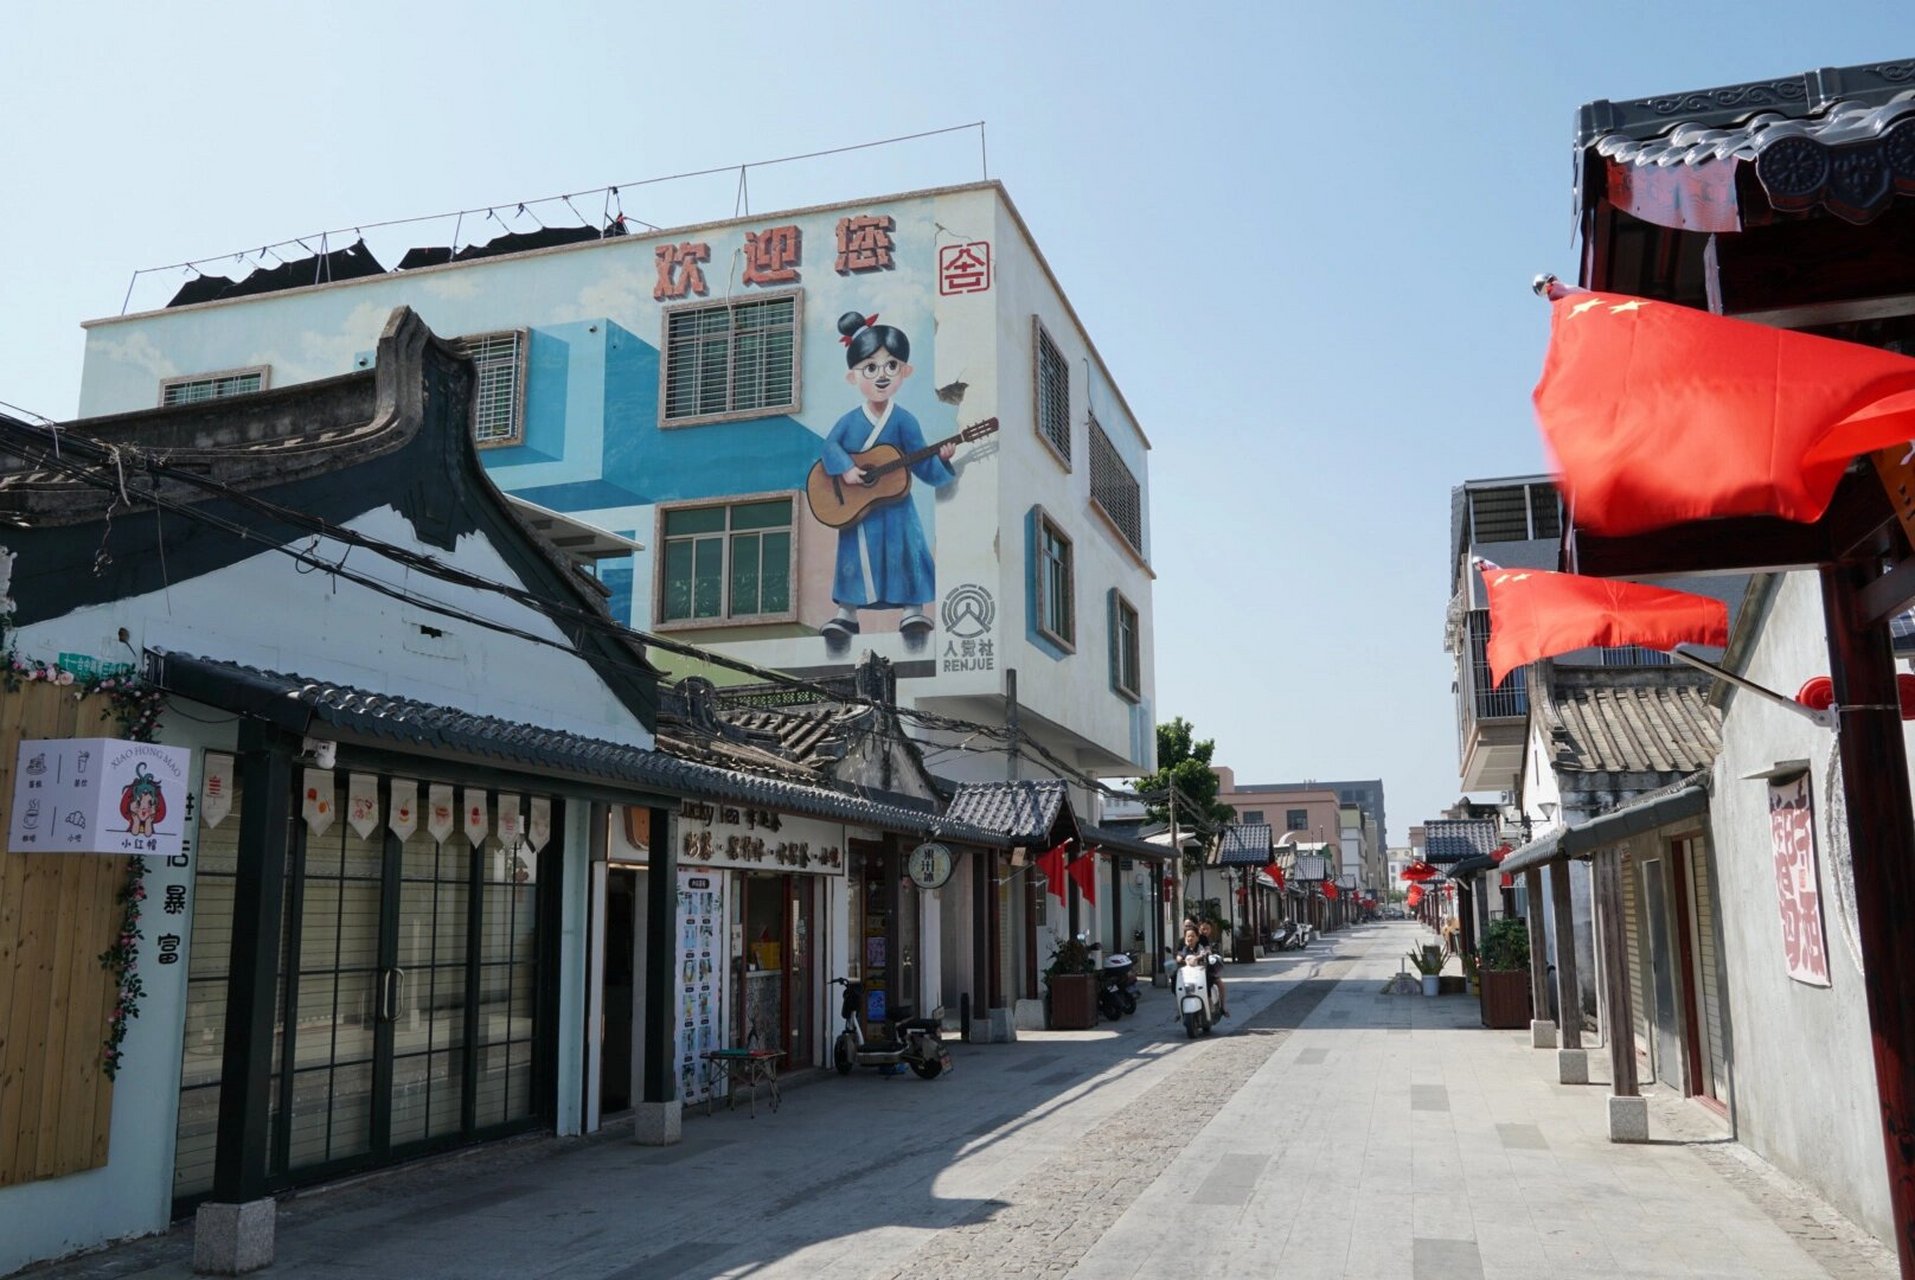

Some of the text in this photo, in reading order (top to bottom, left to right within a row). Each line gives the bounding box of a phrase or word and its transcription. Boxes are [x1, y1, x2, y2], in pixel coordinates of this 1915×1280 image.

[653, 214, 897, 301] 欢迎您
[943, 658, 994, 673] RENJUE
[111, 746, 182, 778] XIAO HONG MAO
[121, 838, 158, 851] 小红帽
